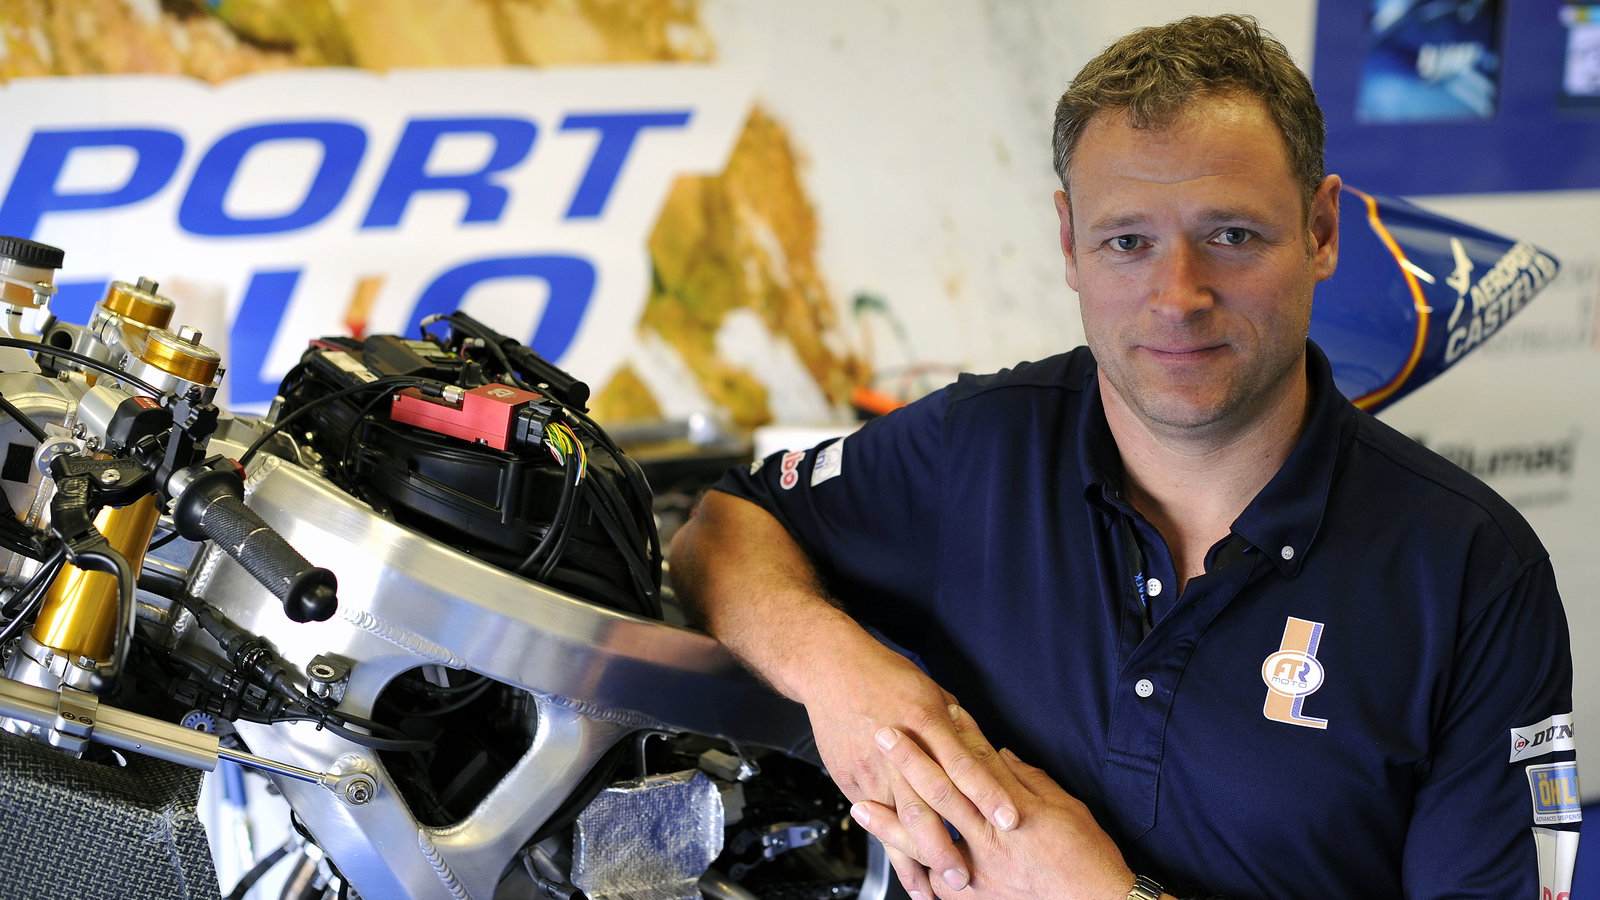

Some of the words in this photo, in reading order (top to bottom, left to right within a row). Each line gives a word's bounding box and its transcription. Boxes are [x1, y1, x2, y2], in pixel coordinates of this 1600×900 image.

[0, 109, 694, 241] PORT
[1273, 658, 1310, 683] FTR
[1530, 722, 1575, 747] DUN
